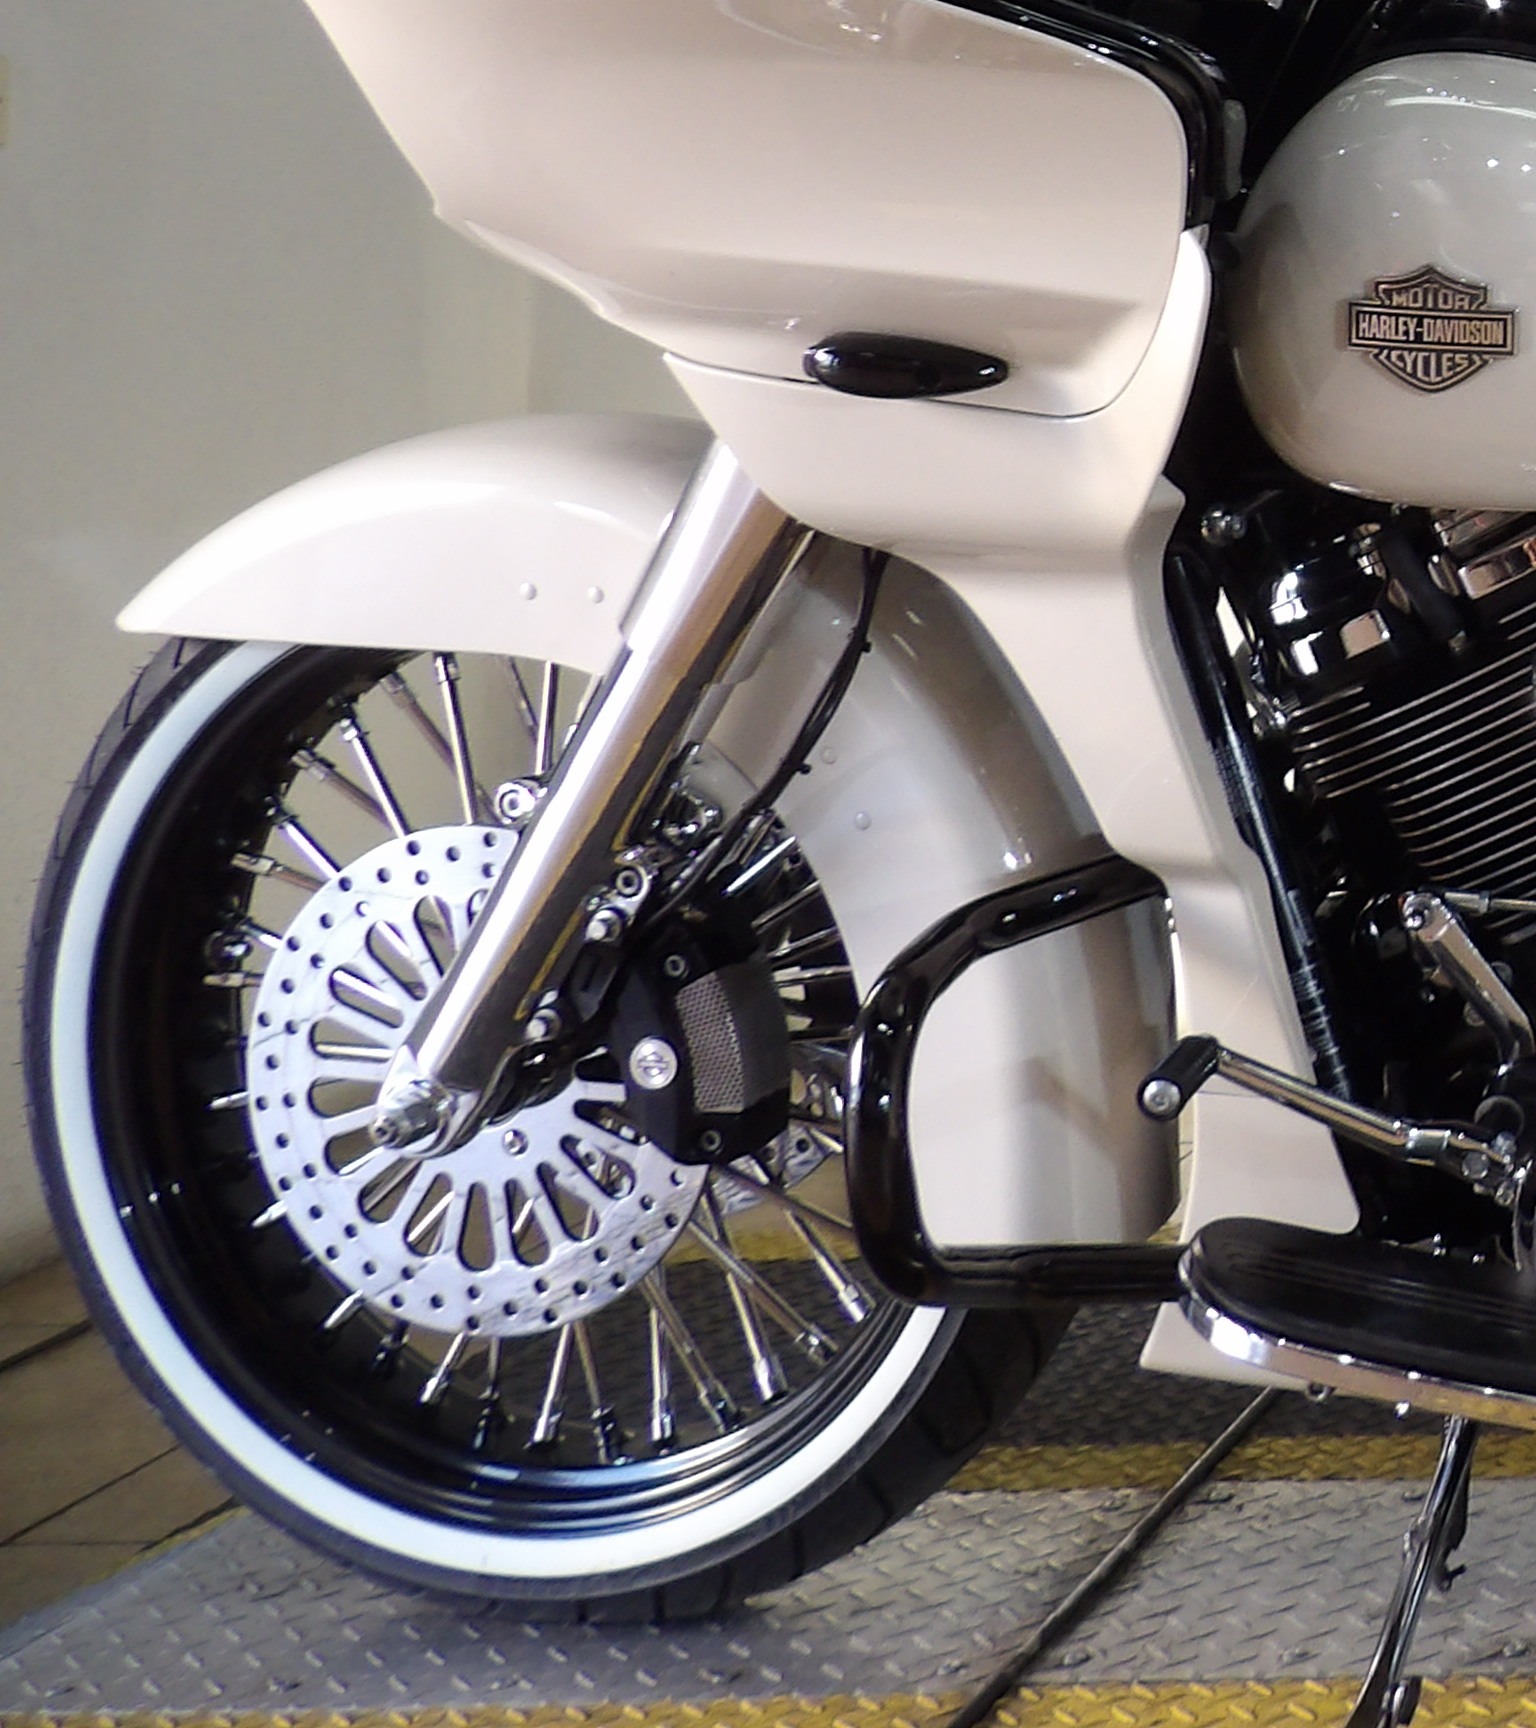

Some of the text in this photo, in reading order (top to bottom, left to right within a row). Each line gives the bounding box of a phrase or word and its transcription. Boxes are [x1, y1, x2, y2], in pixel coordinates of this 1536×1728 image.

[1392, 284, 1471, 310] MOTOR
[1358, 313, 1504, 345] HARLEY-DAVIDSON
[1390, 349, 1470, 383] CYCLES
